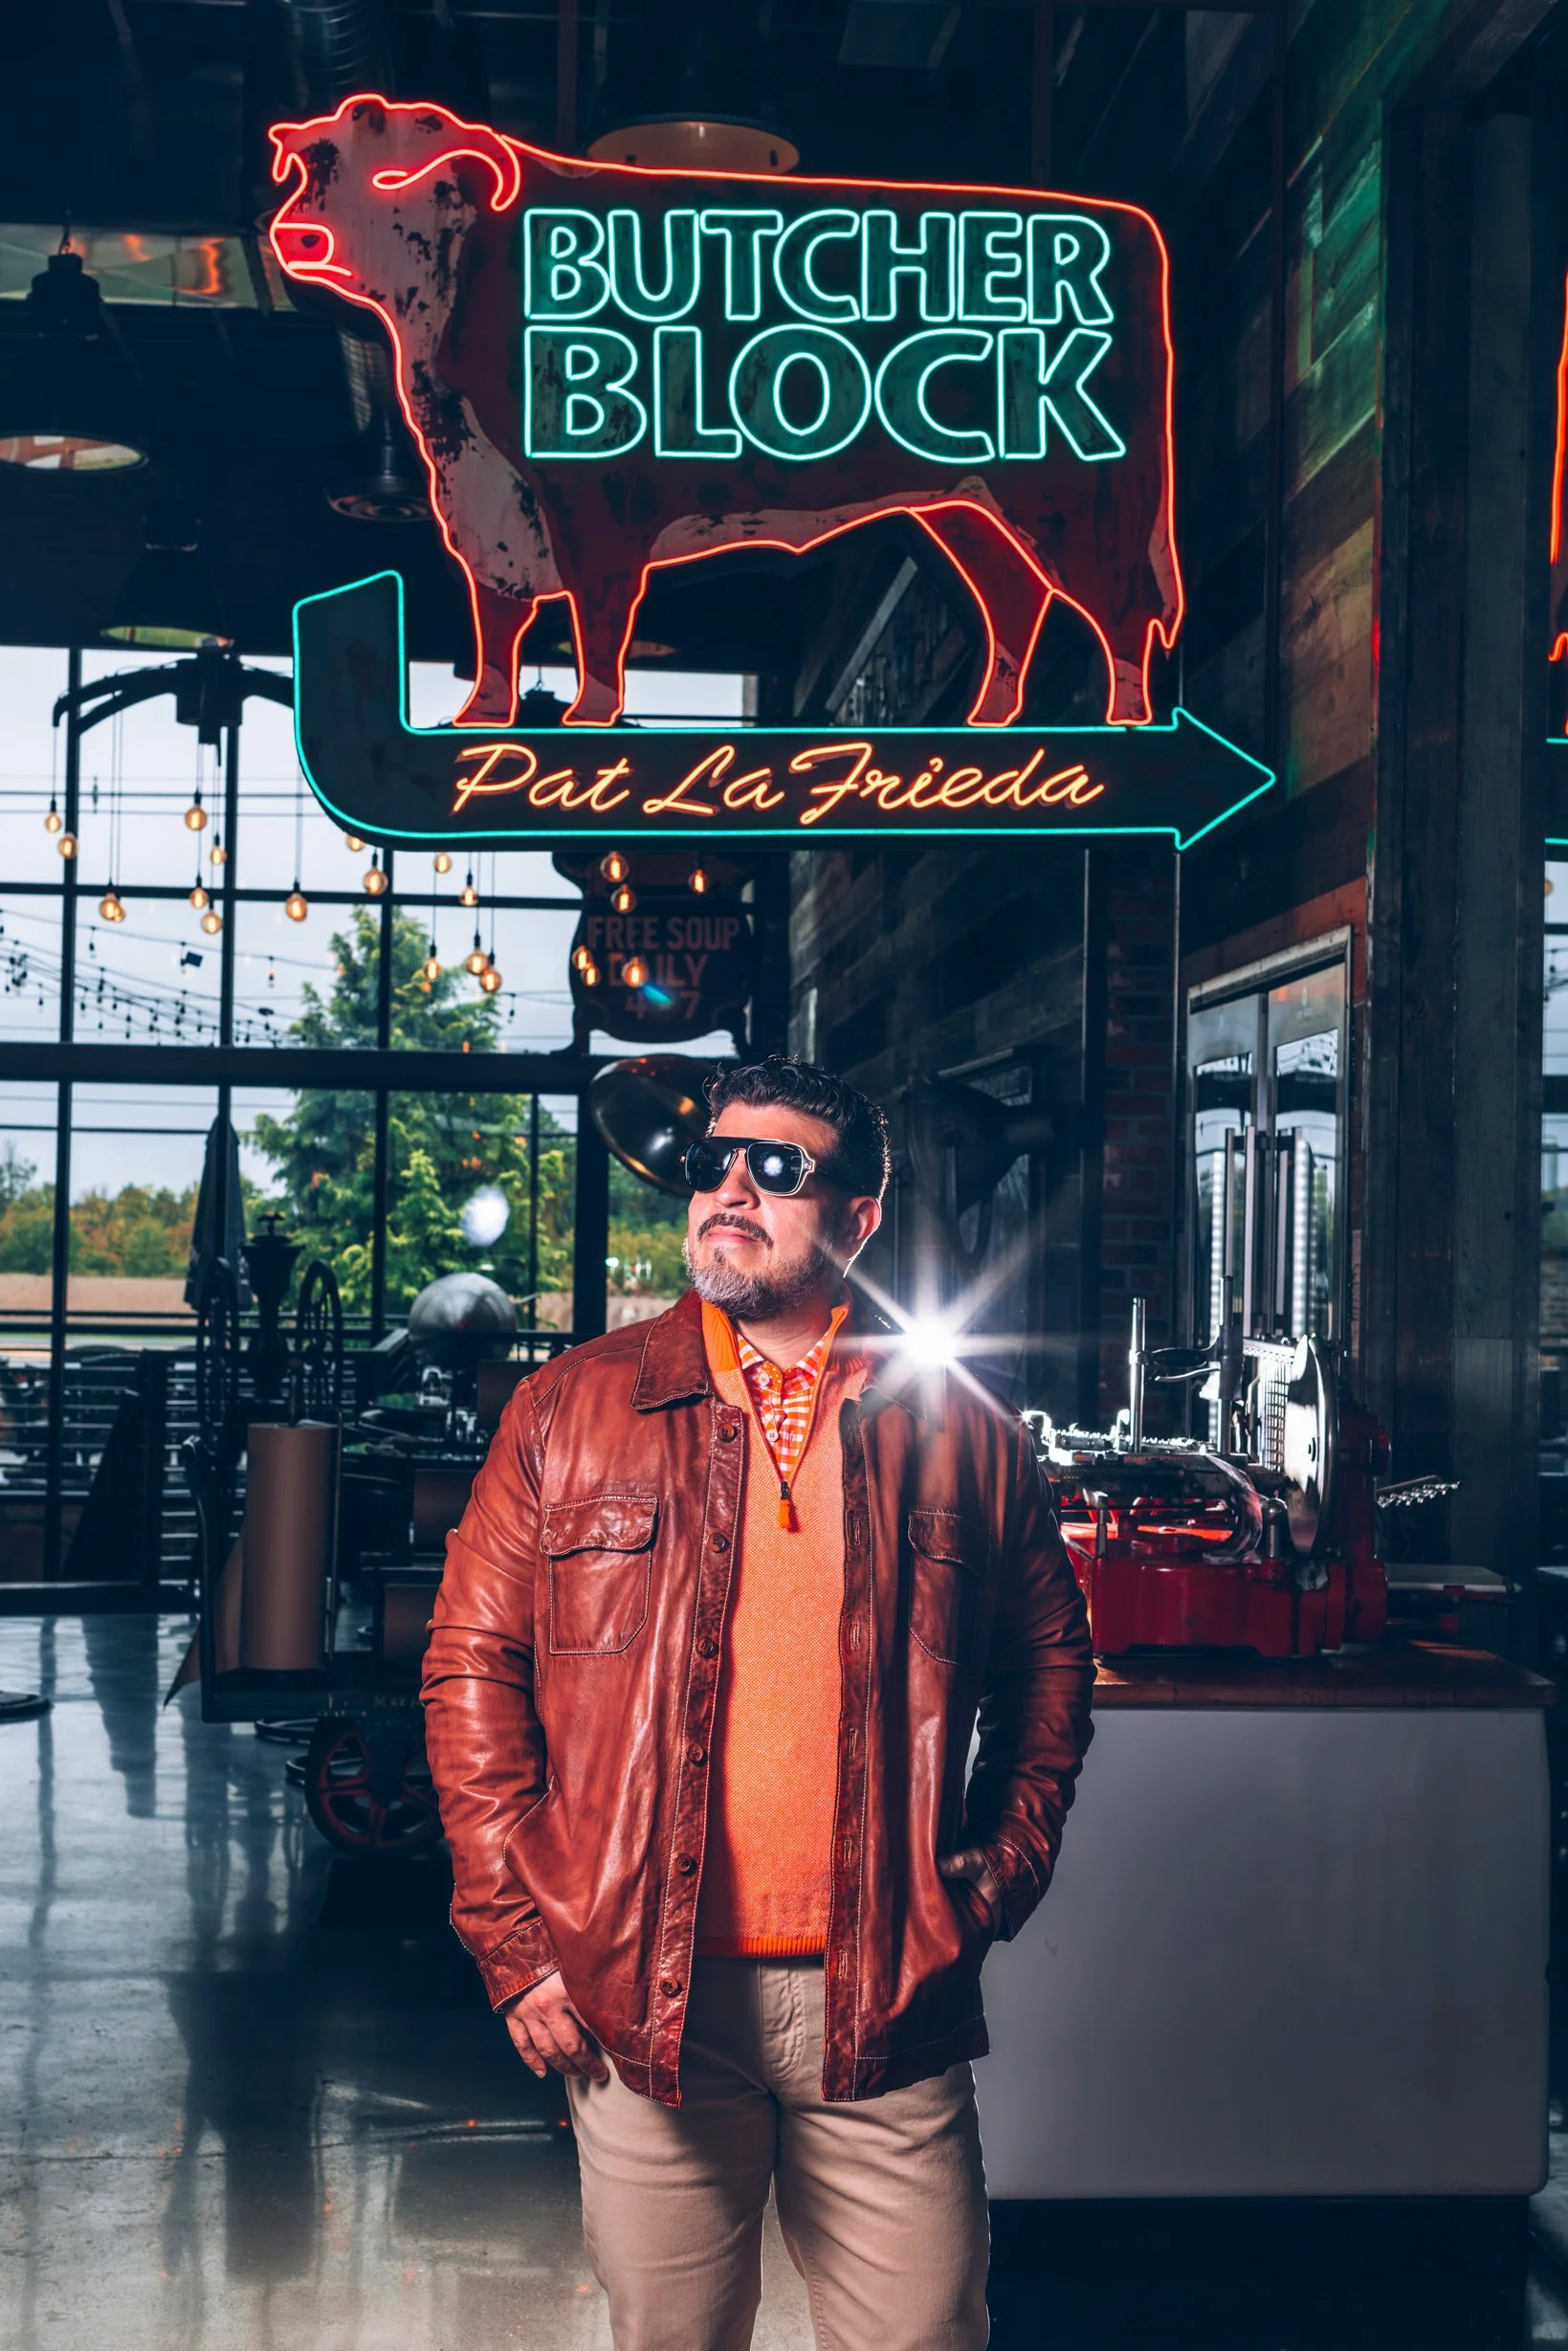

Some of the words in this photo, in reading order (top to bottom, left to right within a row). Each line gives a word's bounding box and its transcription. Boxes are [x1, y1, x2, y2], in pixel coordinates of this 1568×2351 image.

[524, 209, 1115, 325] BUTCHER
[524, 323, 1127, 463] BLOCK
[453, 743, 631, 813] Pat
[642, 744, 784, 815] La
[789, 741, 1105, 824] Frieda
[586, 916, 660, 950] FREE
[666, 916, 741, 951] SOUP
[607, 952, 709, 988] DILY
